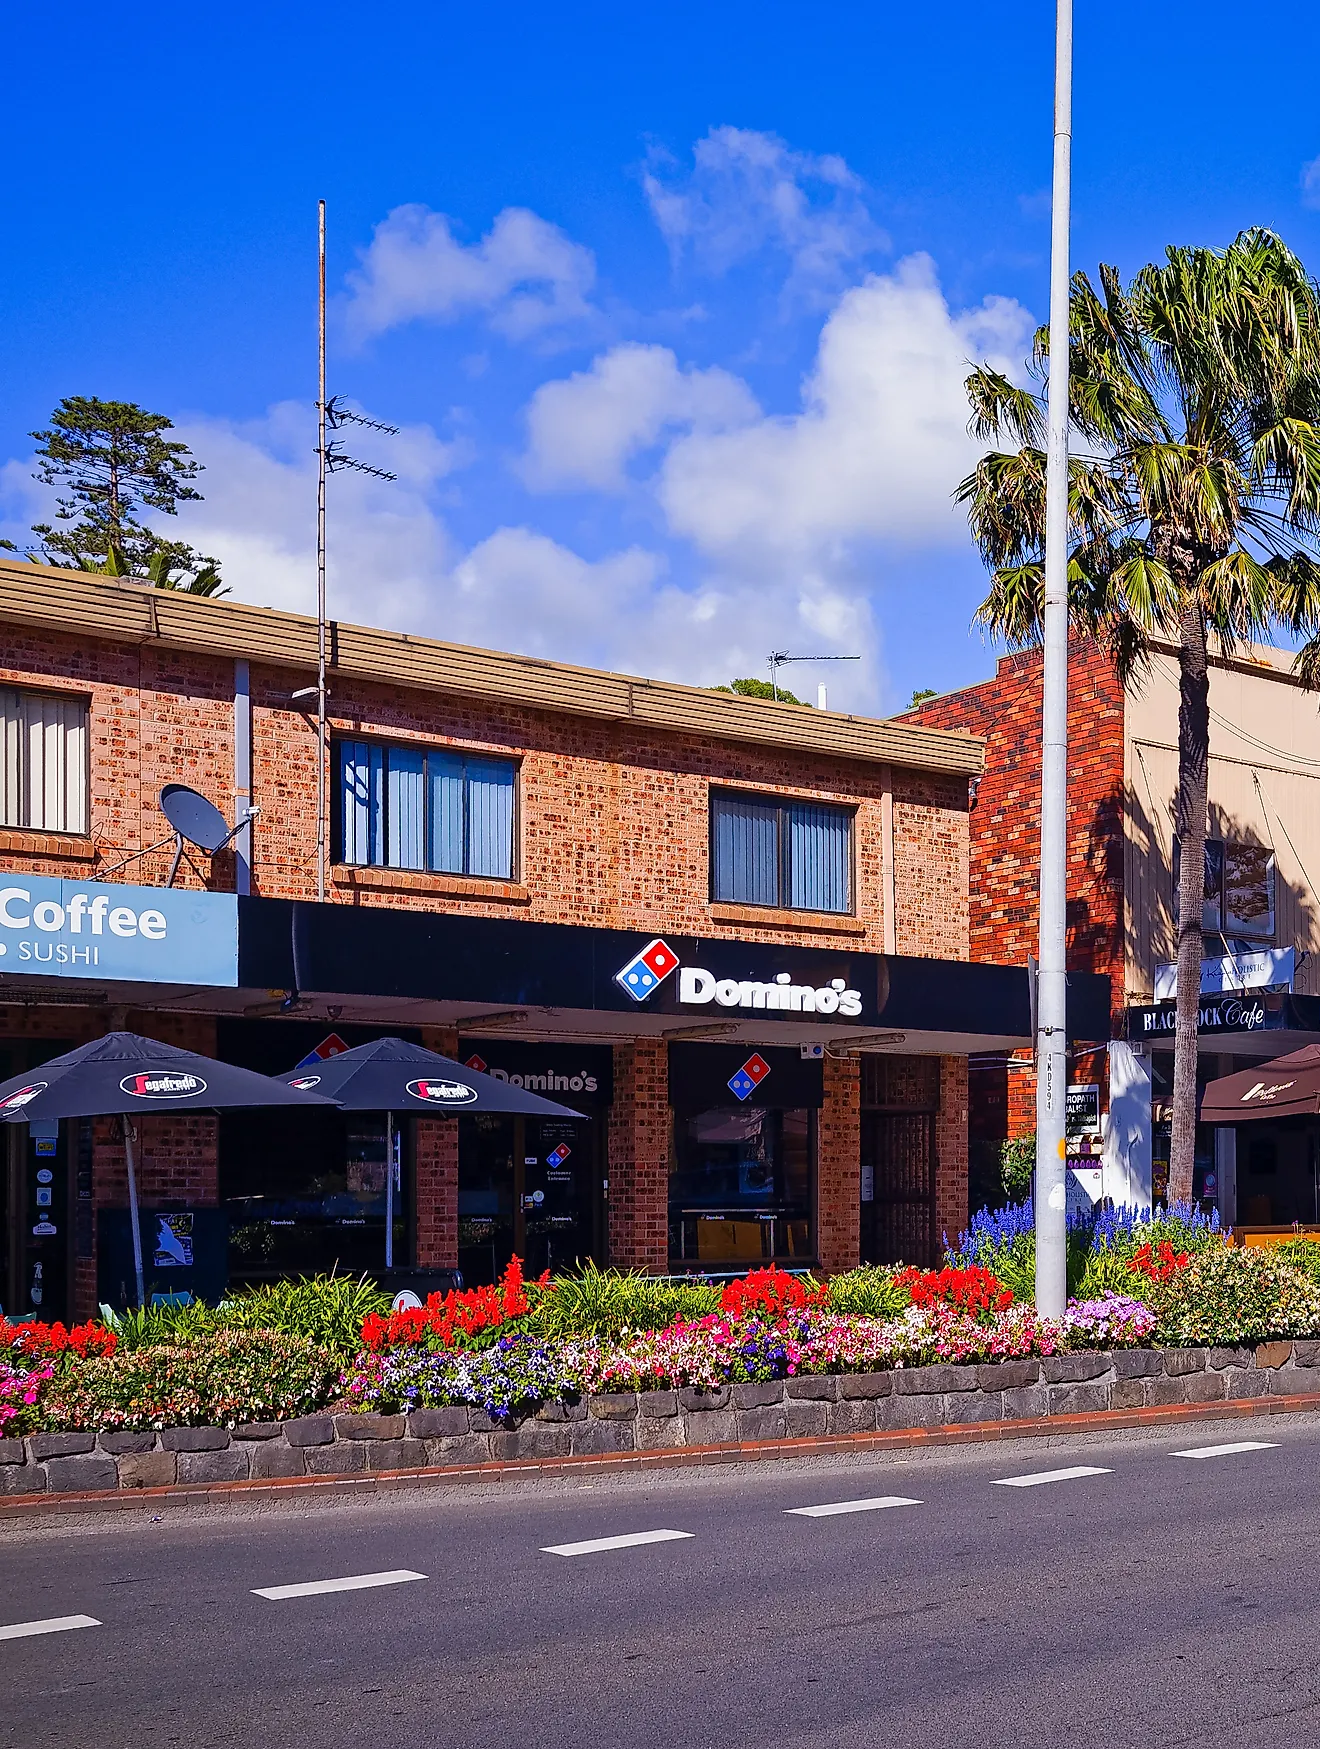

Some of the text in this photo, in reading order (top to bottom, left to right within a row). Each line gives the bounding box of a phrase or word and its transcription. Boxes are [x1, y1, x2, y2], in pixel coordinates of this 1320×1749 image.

[0, 887, 167, 940] Coffee
[18, 941, 99, 965] SUSHI
[678, 967, 863, 1016] Domino's
[1199, 1007, 1222, 1027] OCK
[1221, 998, 1264, 1030] Cafe
[132, 1075, 198, 1095] Segafredo
[489, 1069, 598, 1093] Domino's
[1066, 1094, 1096, 1105] ROPATH
